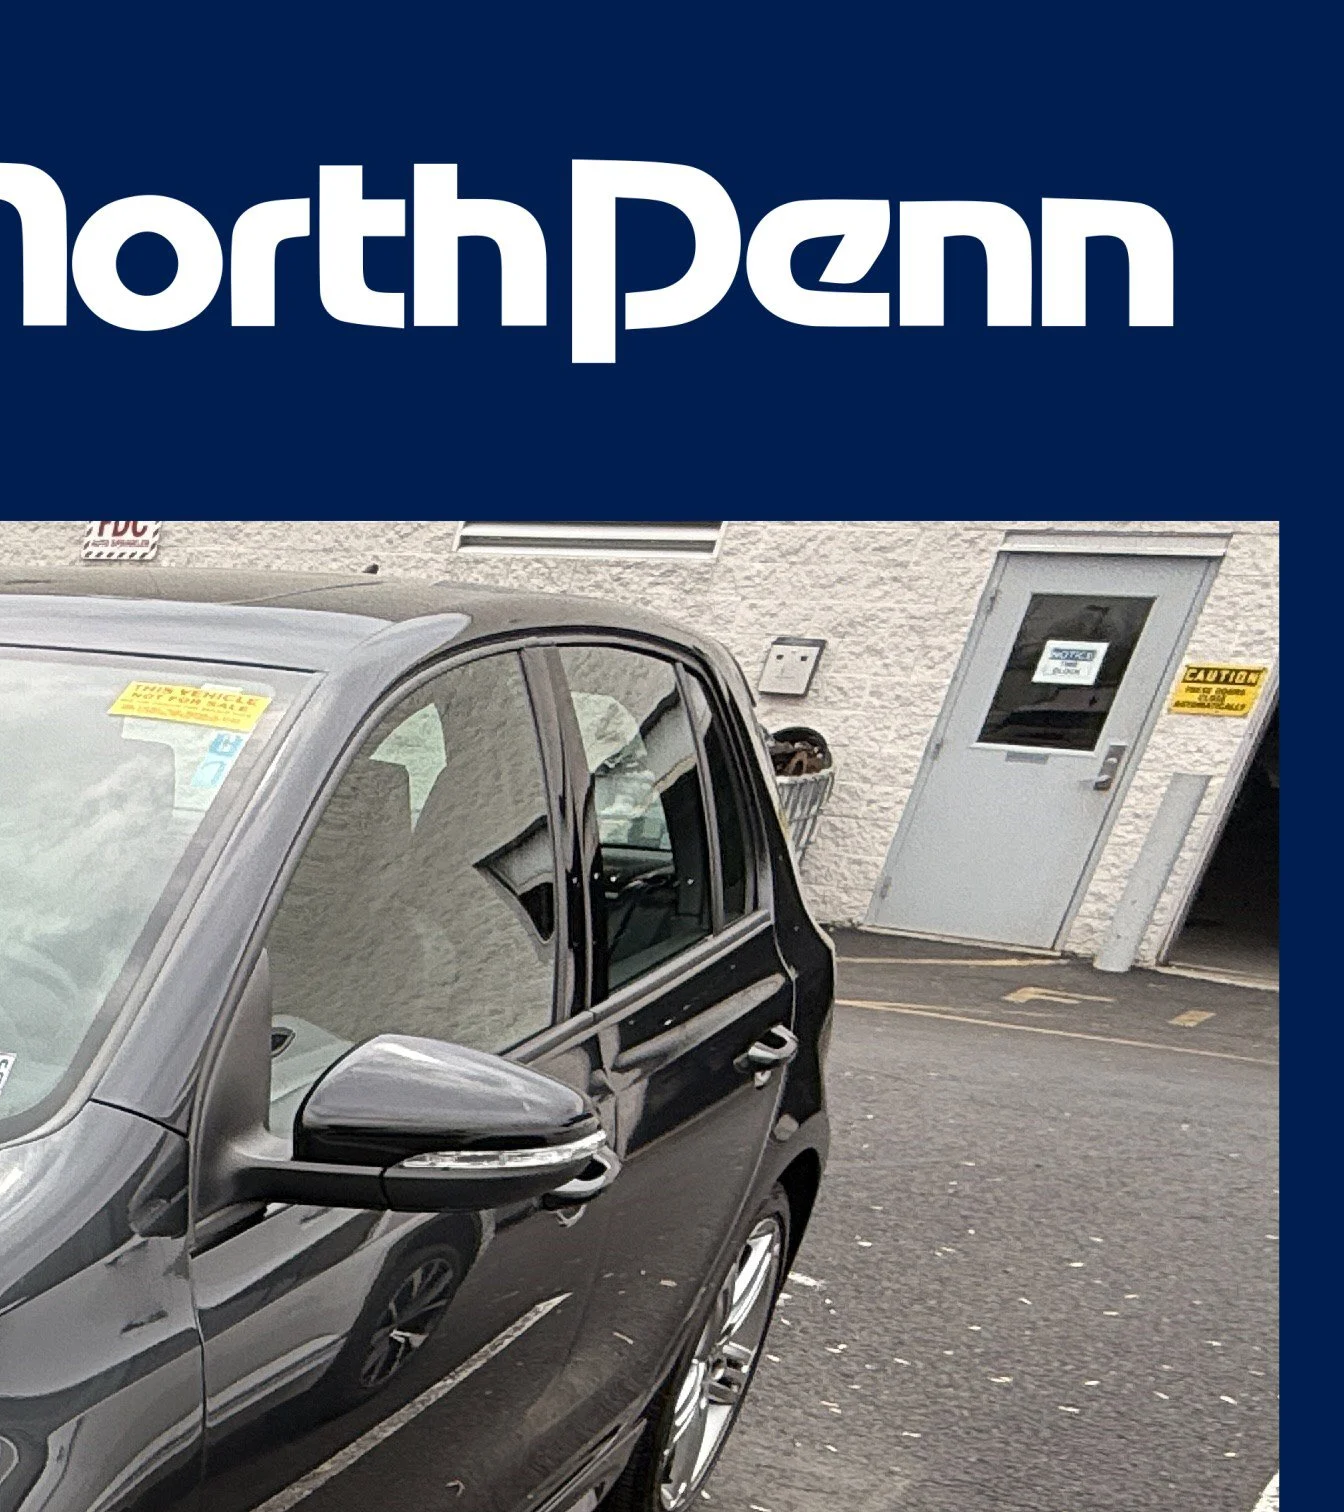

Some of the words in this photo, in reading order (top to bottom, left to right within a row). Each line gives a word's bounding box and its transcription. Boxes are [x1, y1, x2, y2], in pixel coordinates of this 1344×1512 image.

[1185, 668, 1260, 684] CAUTION
[131, 692, 163, 701] NOT
[168, 696, 202, 706] FOR
[206, 701, 248, 713] SALE
[135, 684, 174, 695] THIS
[180, 688, 257, 707] VEHICLE
